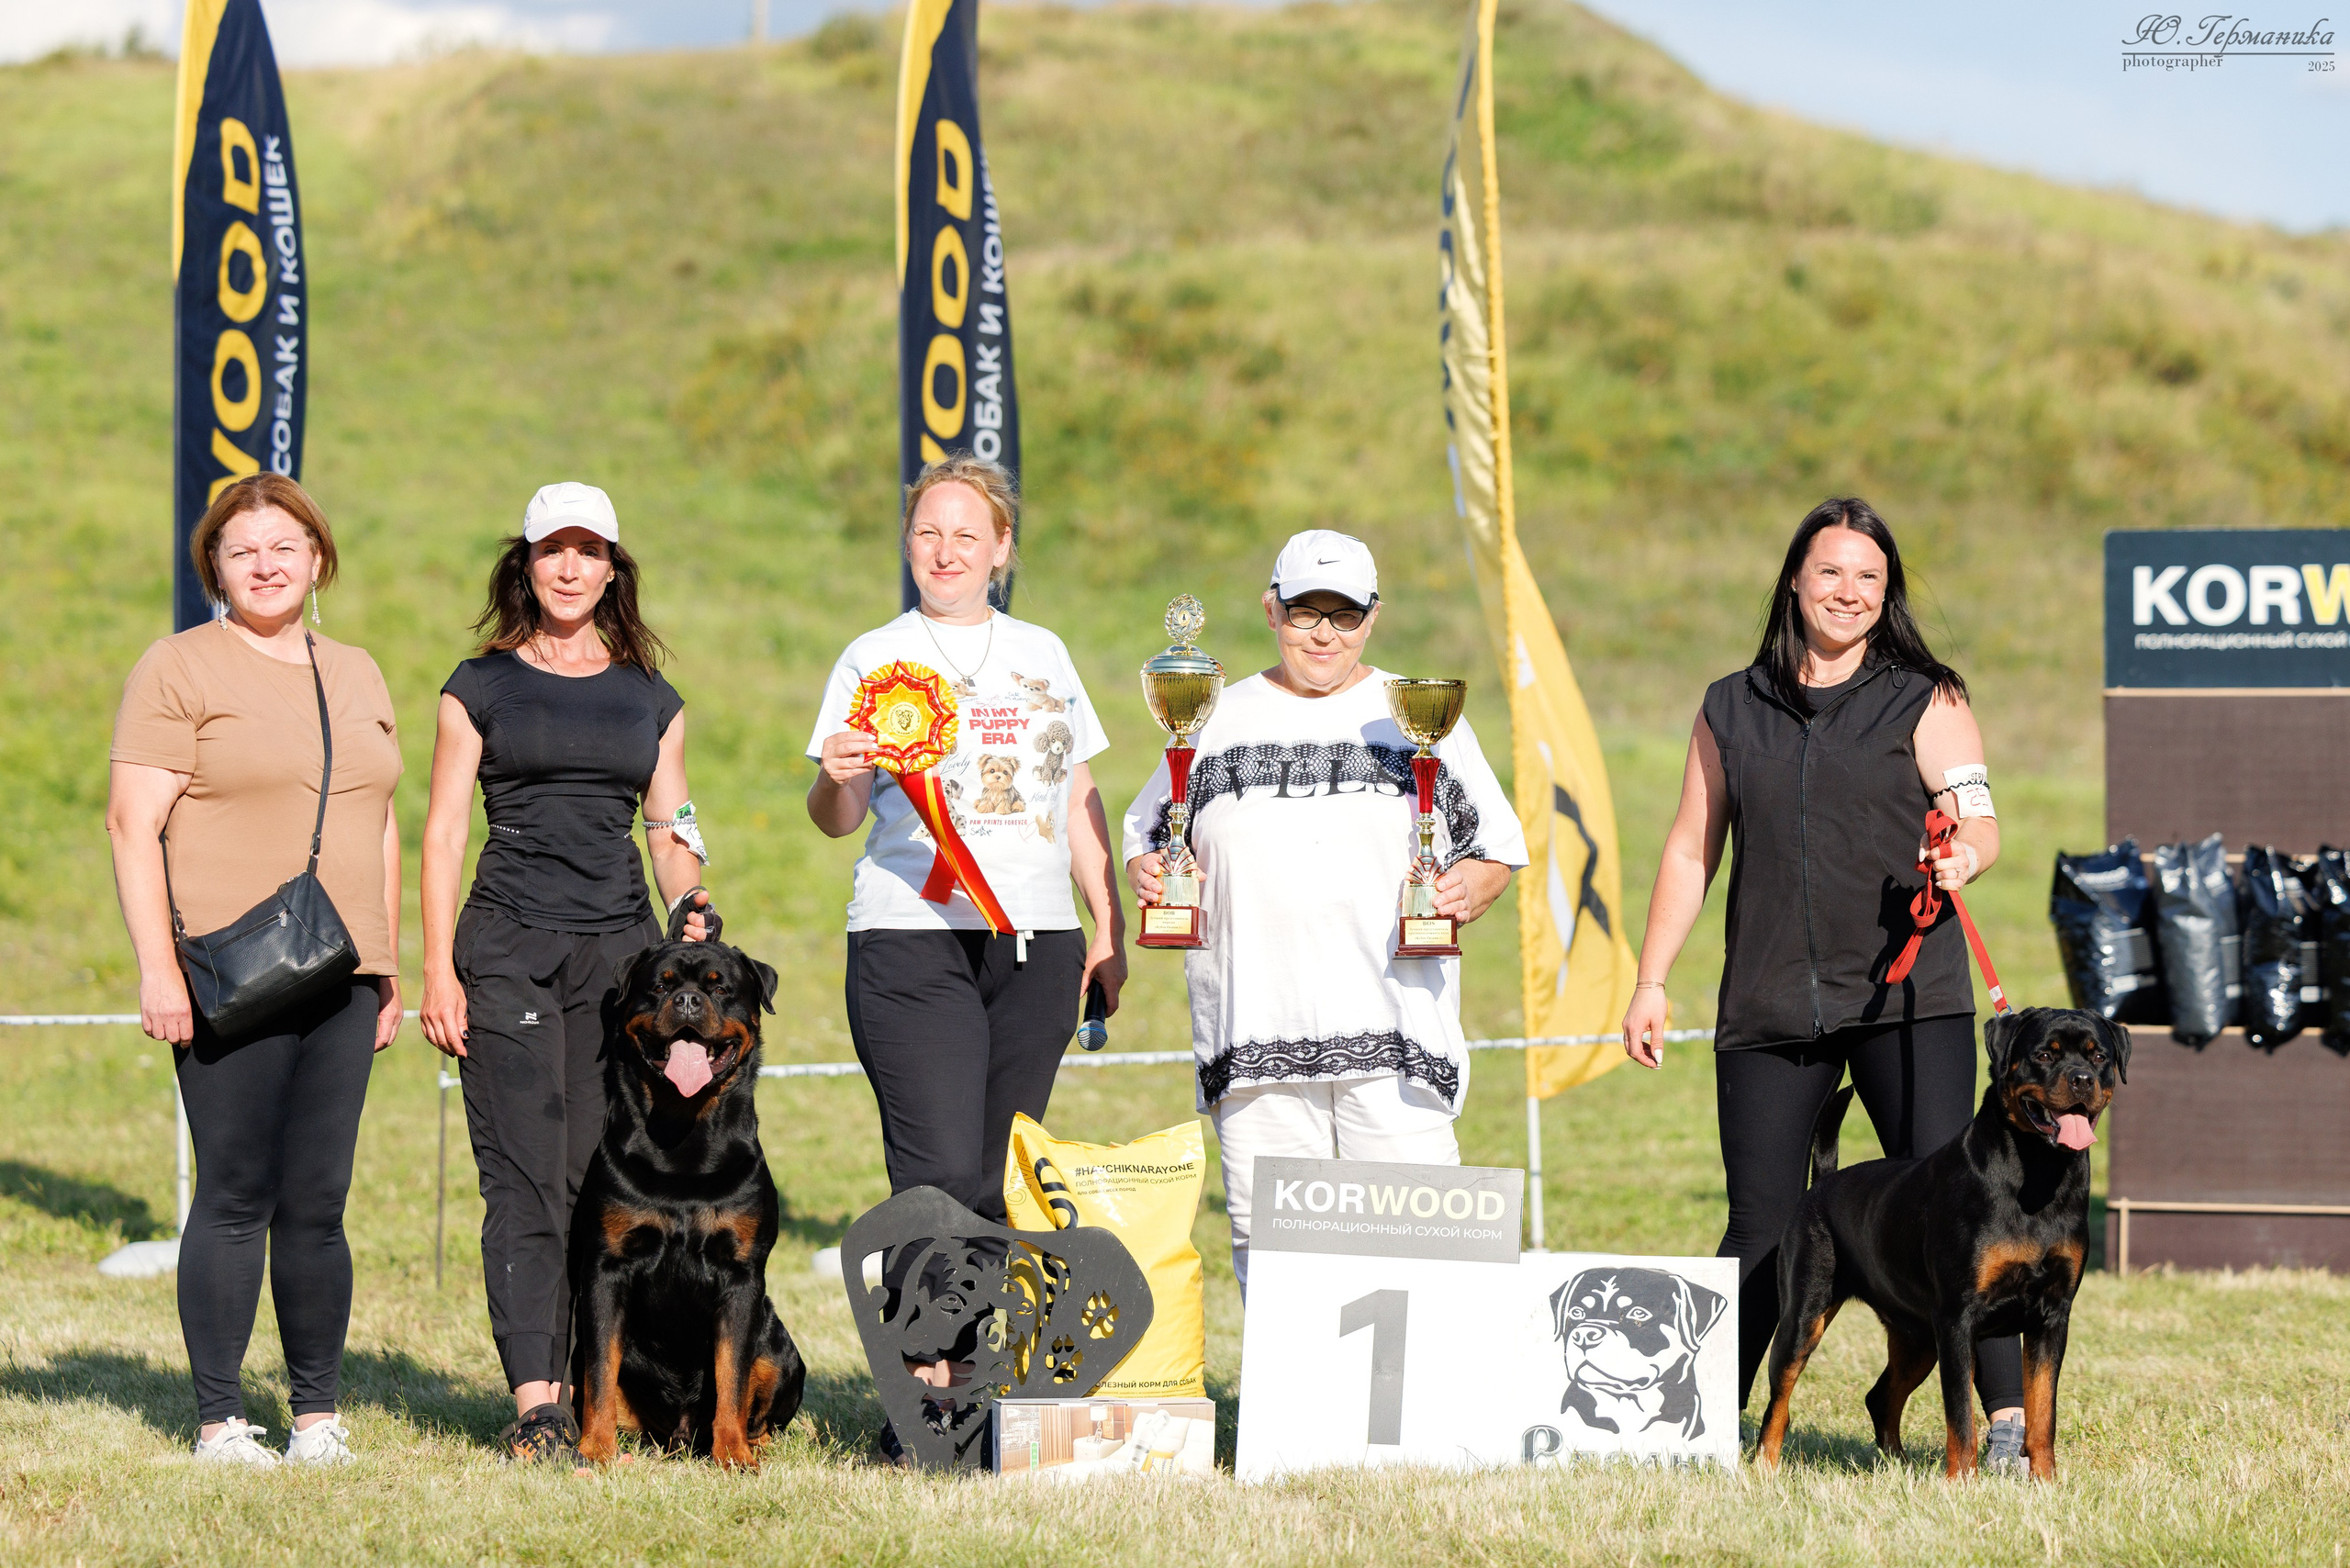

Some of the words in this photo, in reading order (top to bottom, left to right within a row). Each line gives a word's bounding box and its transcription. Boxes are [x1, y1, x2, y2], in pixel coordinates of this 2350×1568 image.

[263, 134, 299, 285] КОШЕК
[921, 118, 974, 465] OOD
[278, 295, 300, 327] И
[978, 302, 1004, 337] И
[974, 343, 1003, 463] ОБАК
[968, 718, 1030, 730] PUPPY
[970, 708, 990, 717] IN
[990, 707, 1019, 717] MY
[981, 733, 1017, 745] ERA
[938, 752, 972, 776] Lovely
[1075, 1177, 1149, 1188] ПОЛНОРАЦИОННЫЙ
[1149, 1177, 1175, 1185] СУХОЙ
[1175, 1173, 1197, 1182] КОРМ
[1274, 1179, 1506, 1222] KORWOOD
[1272, 1217, 1412, 1236] ПОЛНОРАЦИОННЫЙ
[1415, 1224, 1460, 1238] СУХОЙ
[1463, 1227, 1503, 1240] КОРМ
[1338, 1288, 1410, 1446] 1
[1095, 1380, 1136, 1388] ОЛЕЗНЫЙ
[1179, 1376, 1197, 1386] СОБАК
